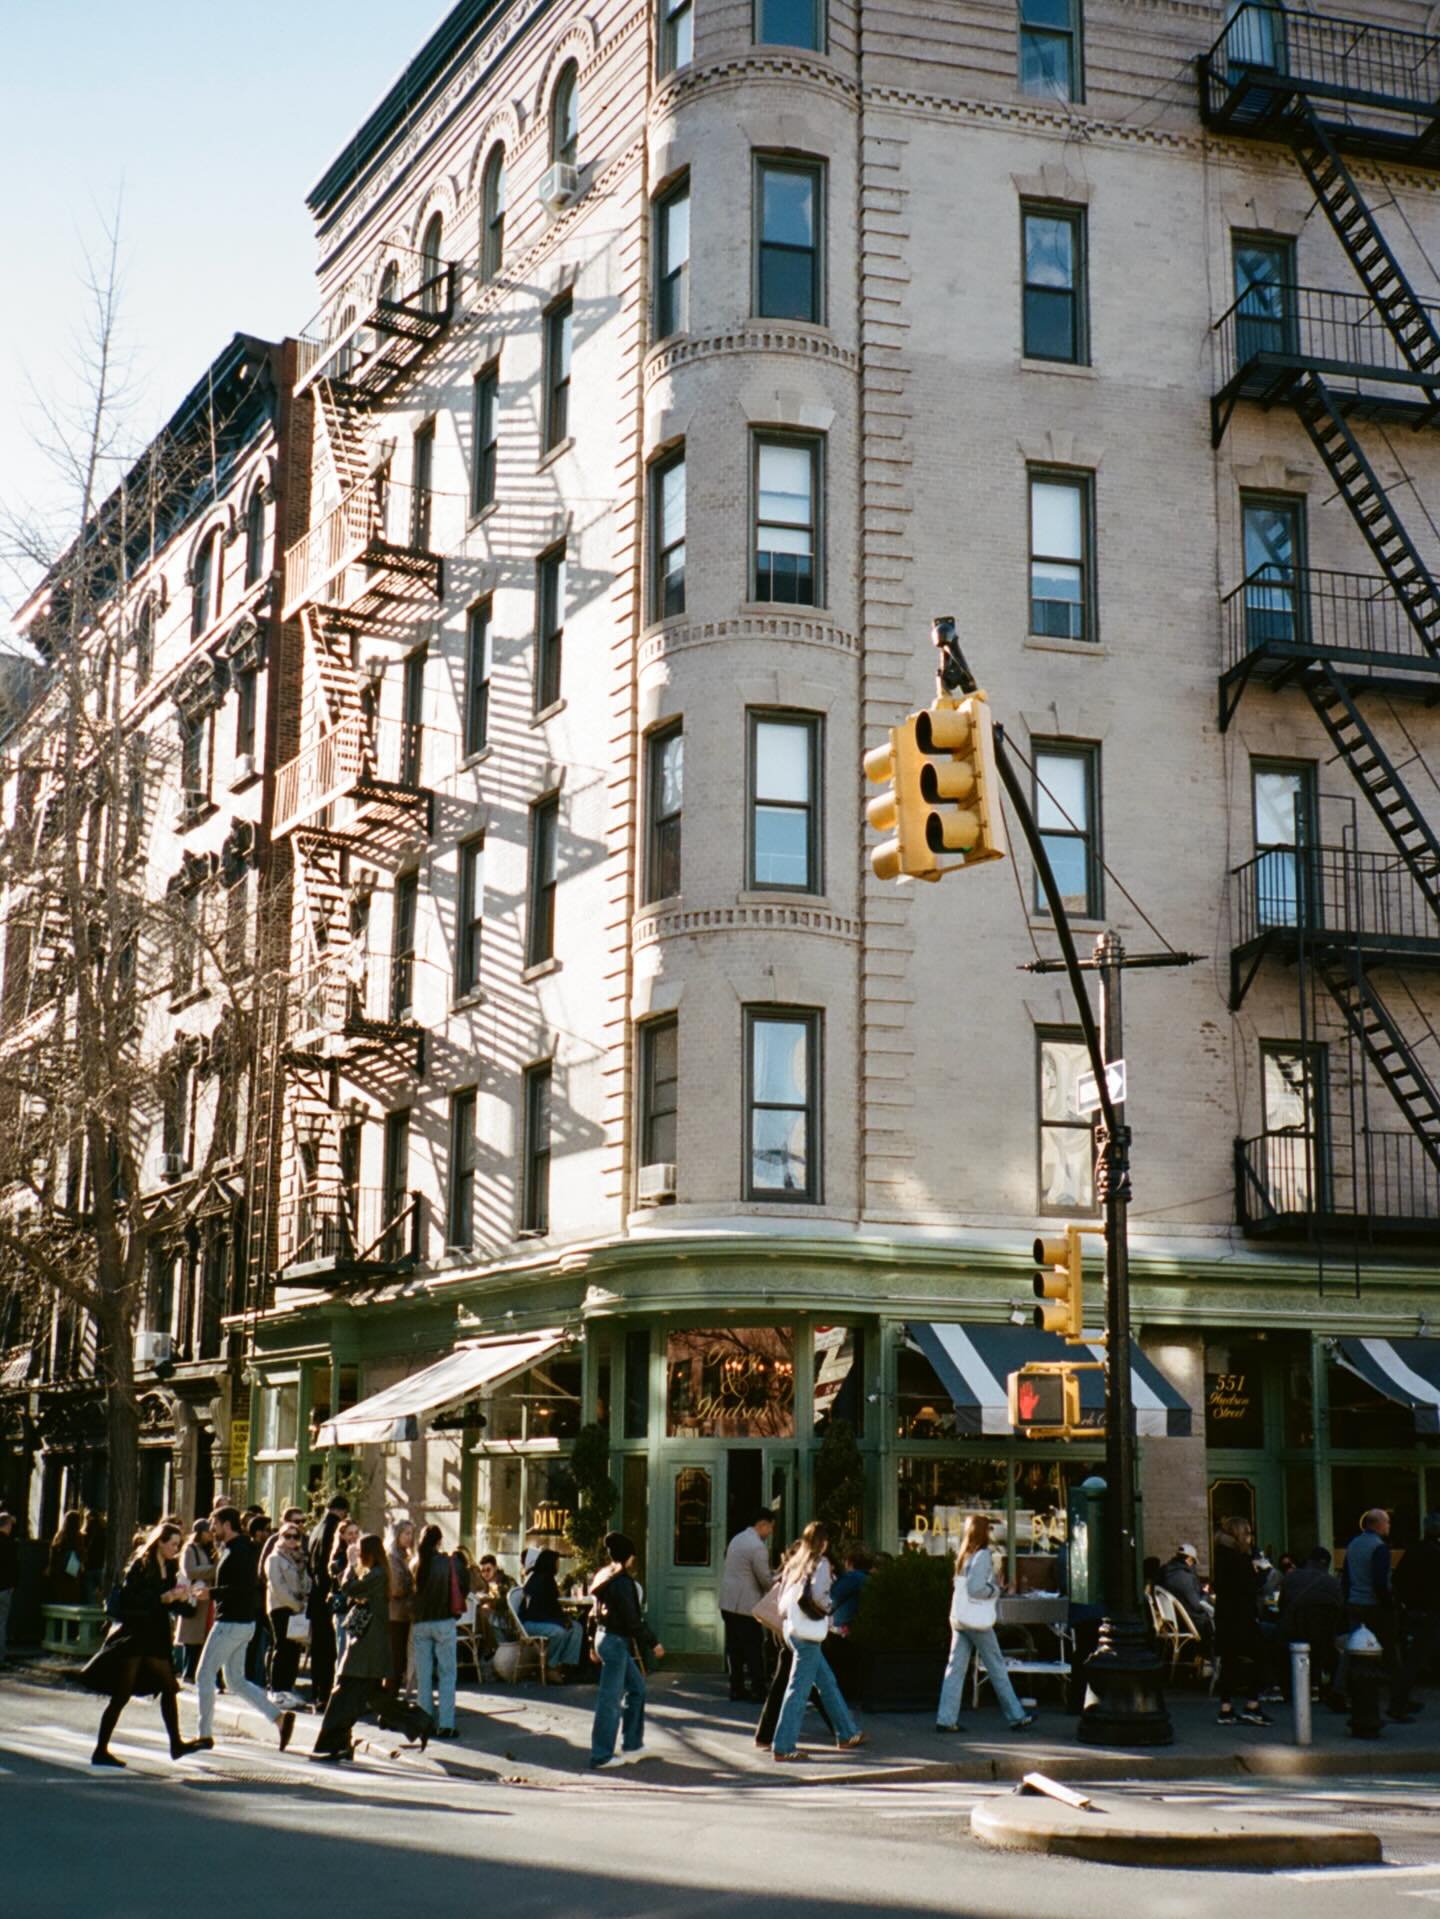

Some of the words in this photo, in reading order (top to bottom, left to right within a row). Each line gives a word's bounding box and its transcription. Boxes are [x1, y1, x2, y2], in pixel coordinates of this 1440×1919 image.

[1215, 1374, 1245, 1391] 551
[1209, 1391, 1249, 1406] Hudson
[695, 1395, 770, 1420] Hudson
[1213, 1407, 1246, 1419] Street
